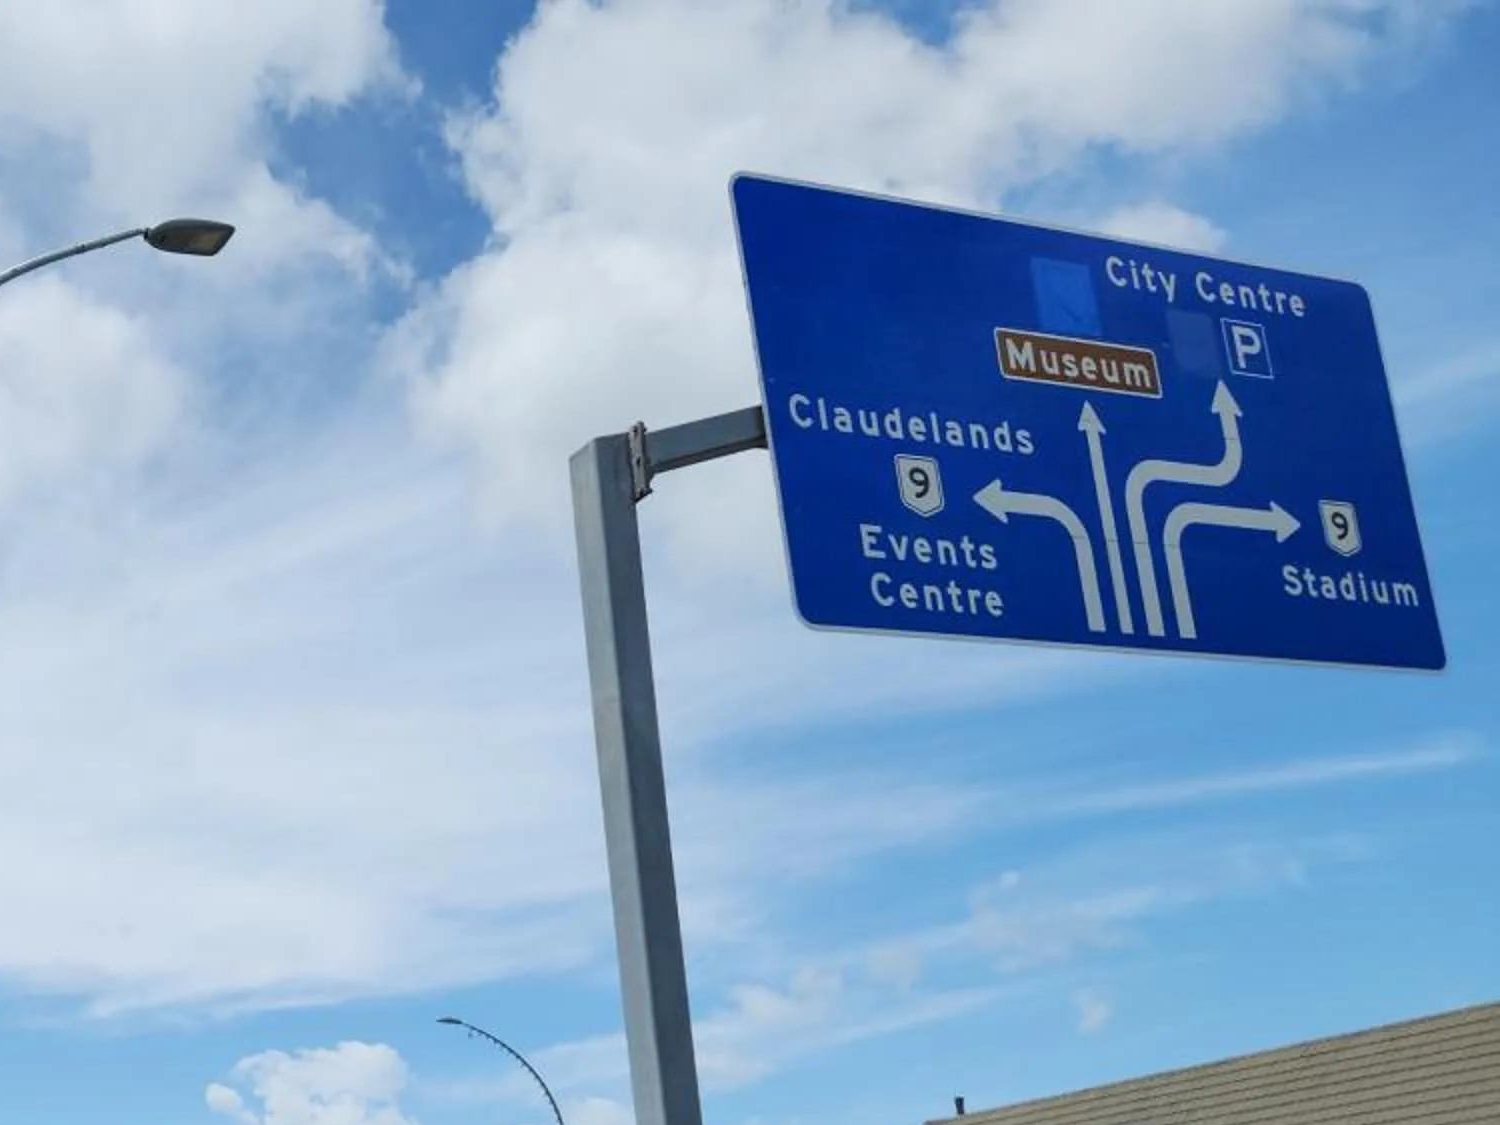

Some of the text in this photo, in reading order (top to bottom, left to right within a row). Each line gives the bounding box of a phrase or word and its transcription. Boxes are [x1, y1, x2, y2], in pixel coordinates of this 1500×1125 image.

[1106, 255, 1307, 318] City Centre
[1003, 338, 1152, 389] Museum
[1231, 326, 1263, 369] P
[788, 394, 1035, 456] Claudelands
[909, 467, 931, 500] 9
[860, 523, 998, 570] Events
[1330, 511, 1350, 540] 9
[870, 572, 1005, 617] Centre
[1282, 565, 1419, 607] Stadium
